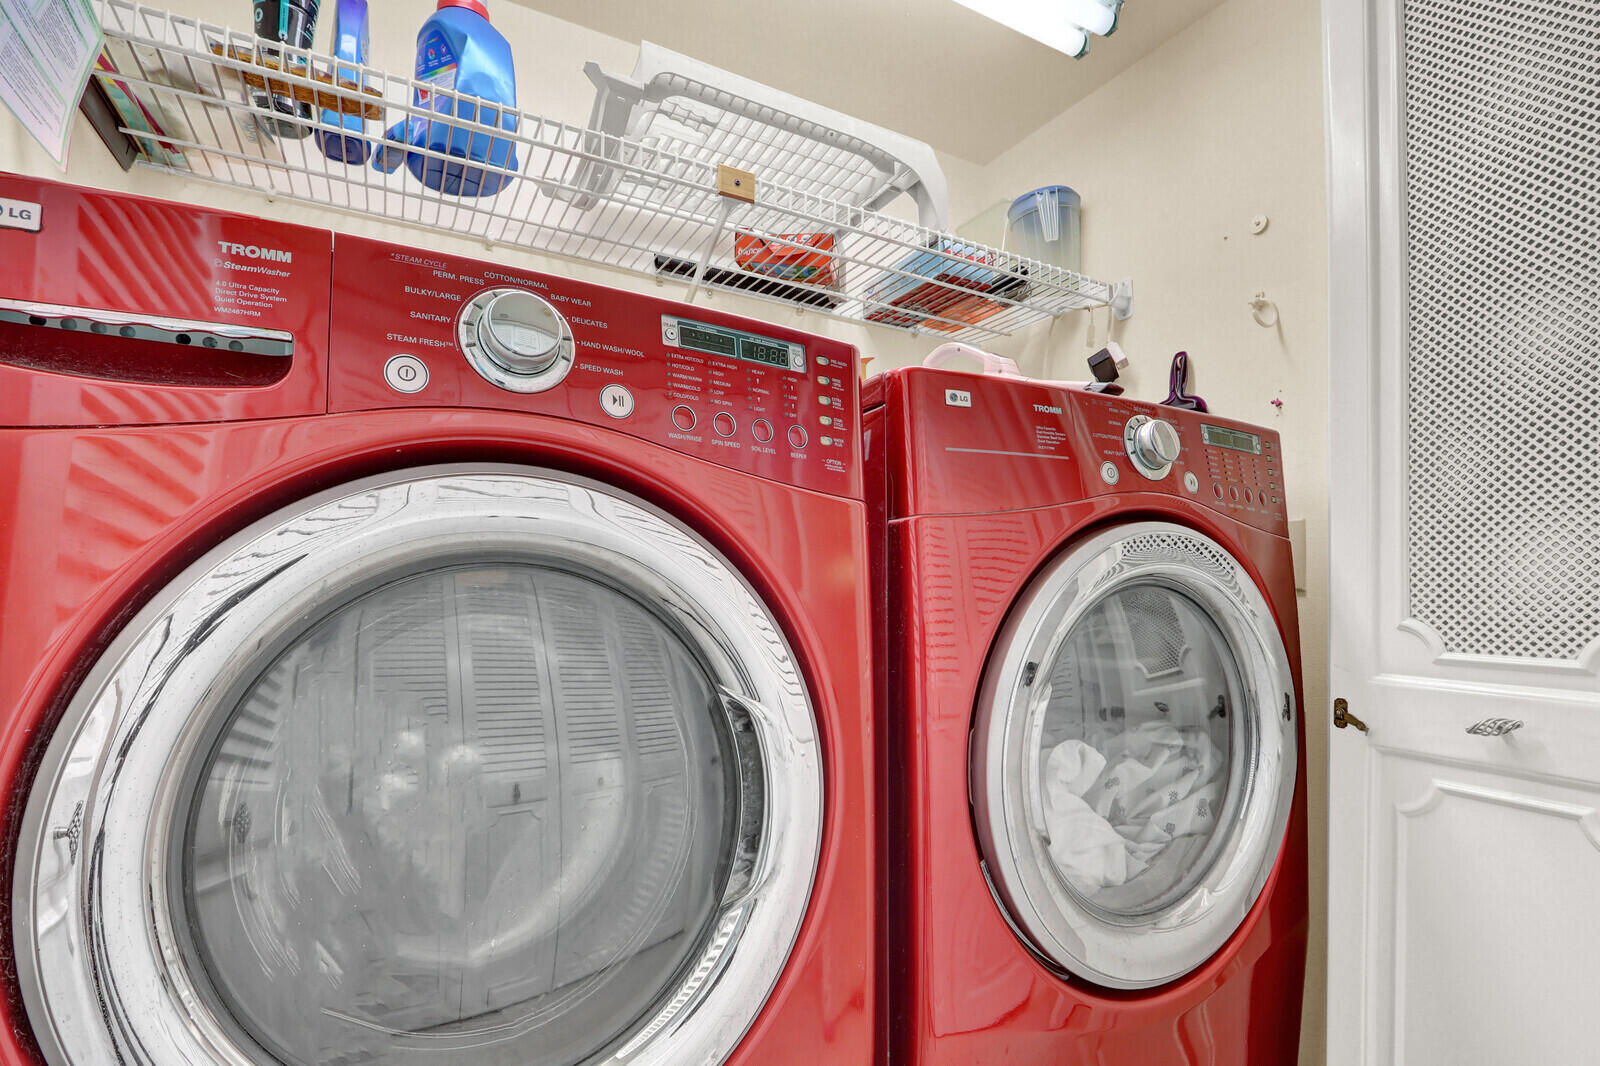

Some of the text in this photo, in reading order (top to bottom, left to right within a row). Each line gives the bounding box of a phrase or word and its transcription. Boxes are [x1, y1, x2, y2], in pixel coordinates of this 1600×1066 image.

[9, 208, 32, 220] LG
[218, 240, 292, 263] TROMM
[224, 261, 291, 278] SteamWasher
[424, 260, 448, 269] CYCLE
[433, 270, 485, 286] PERM. PRESS
[484, 272, 549, 290] COTTON/NORMAL
[229, 281, 246, 290] Ultra
[248, 283, 280, 294] Capacity
[404, 285, 462, 301] BULKY/LARGE
[214, 295, 273, 308] Quiet Operation
[215, 288, 287, 302] Direct Drive System
[550, 293, 592, 307] BABY WEAR
[410, 310, 451, 324] SANITARY
[572, 316, 608, 329] DELICATES
[386, 333, 417, 344] STEAM
[581, 340, 645, 357] HAND WASH/WOOL
[580, 363, 624, 376] SPEED WASH
[1032, 404, 1062, 414] TROMM
